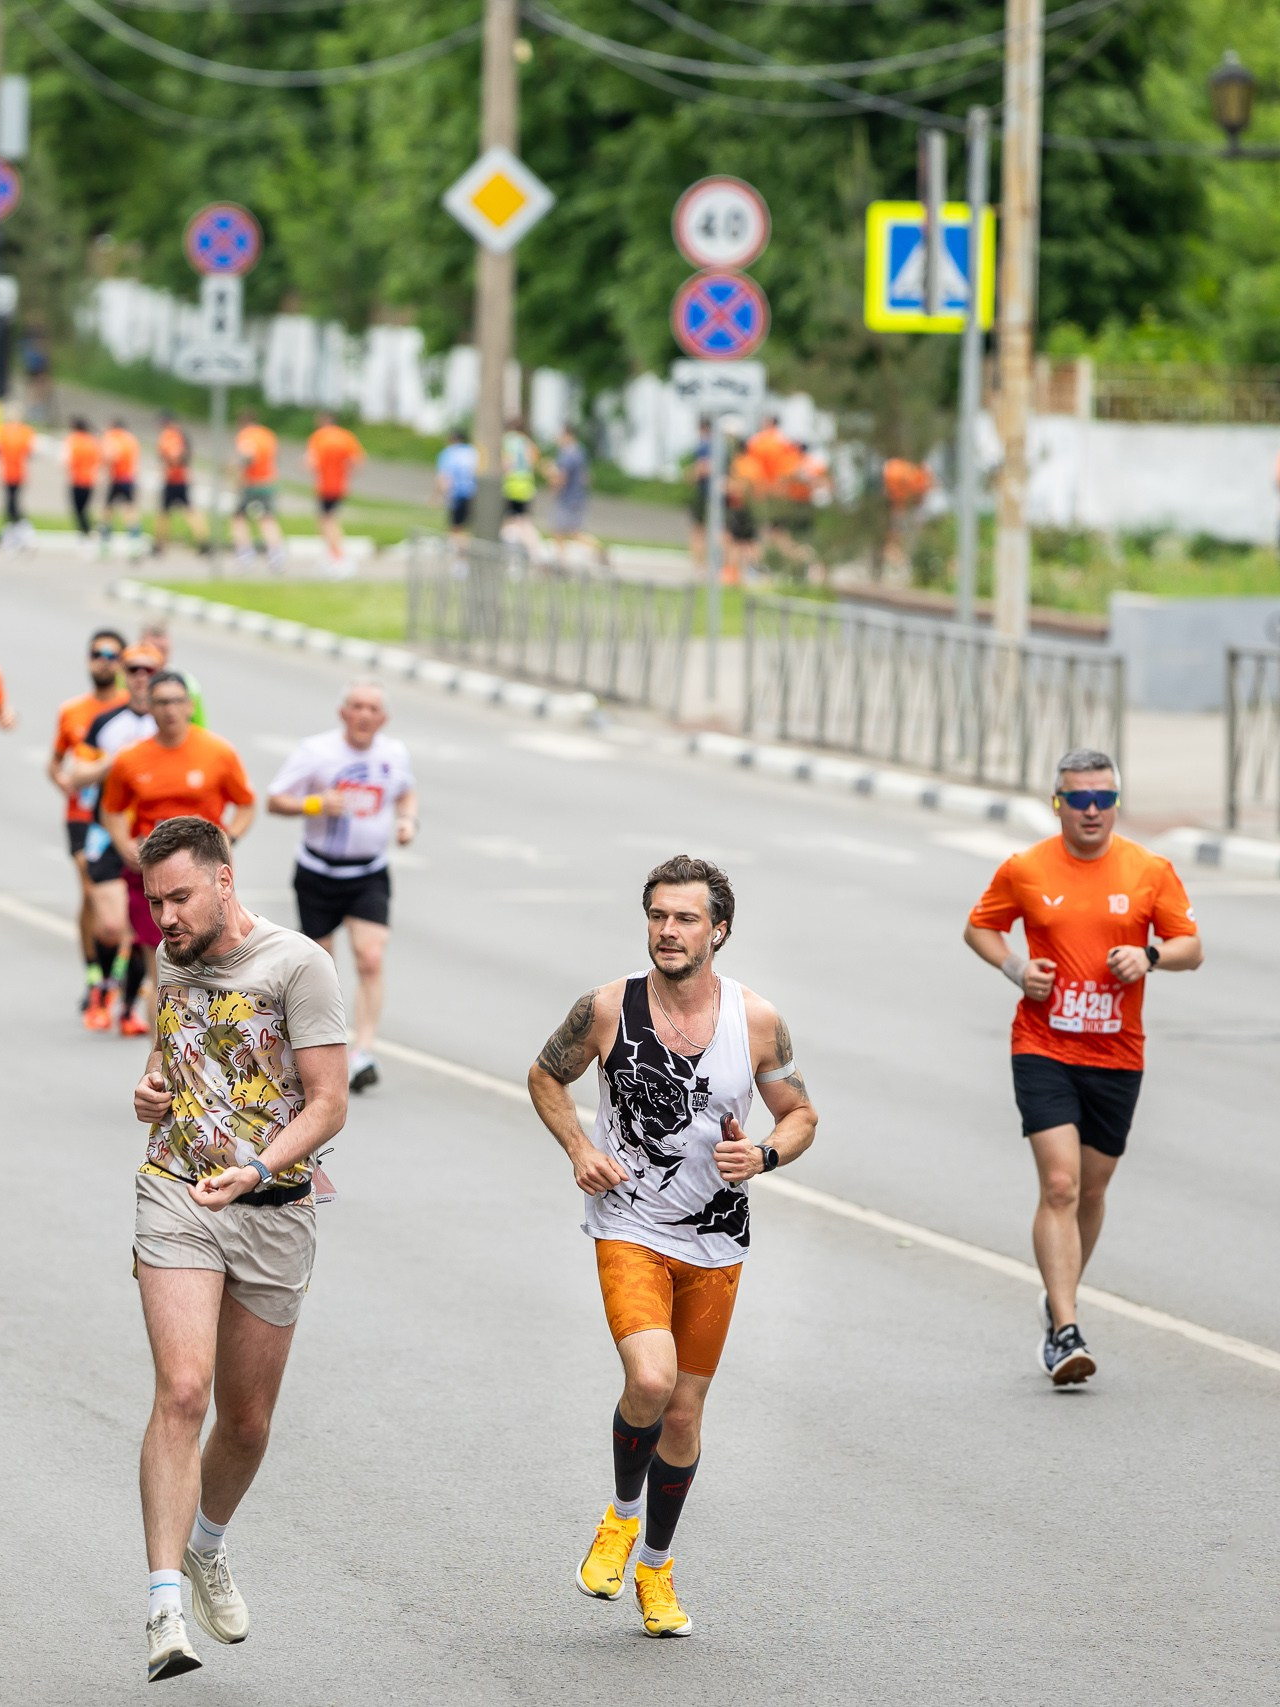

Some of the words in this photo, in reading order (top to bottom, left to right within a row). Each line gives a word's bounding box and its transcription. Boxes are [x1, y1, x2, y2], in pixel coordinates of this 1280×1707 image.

[696, 206, 749, 242] 40
[1108, 894, 1129, 914] 10
[1062, 989, 1113, 1020] 5429
